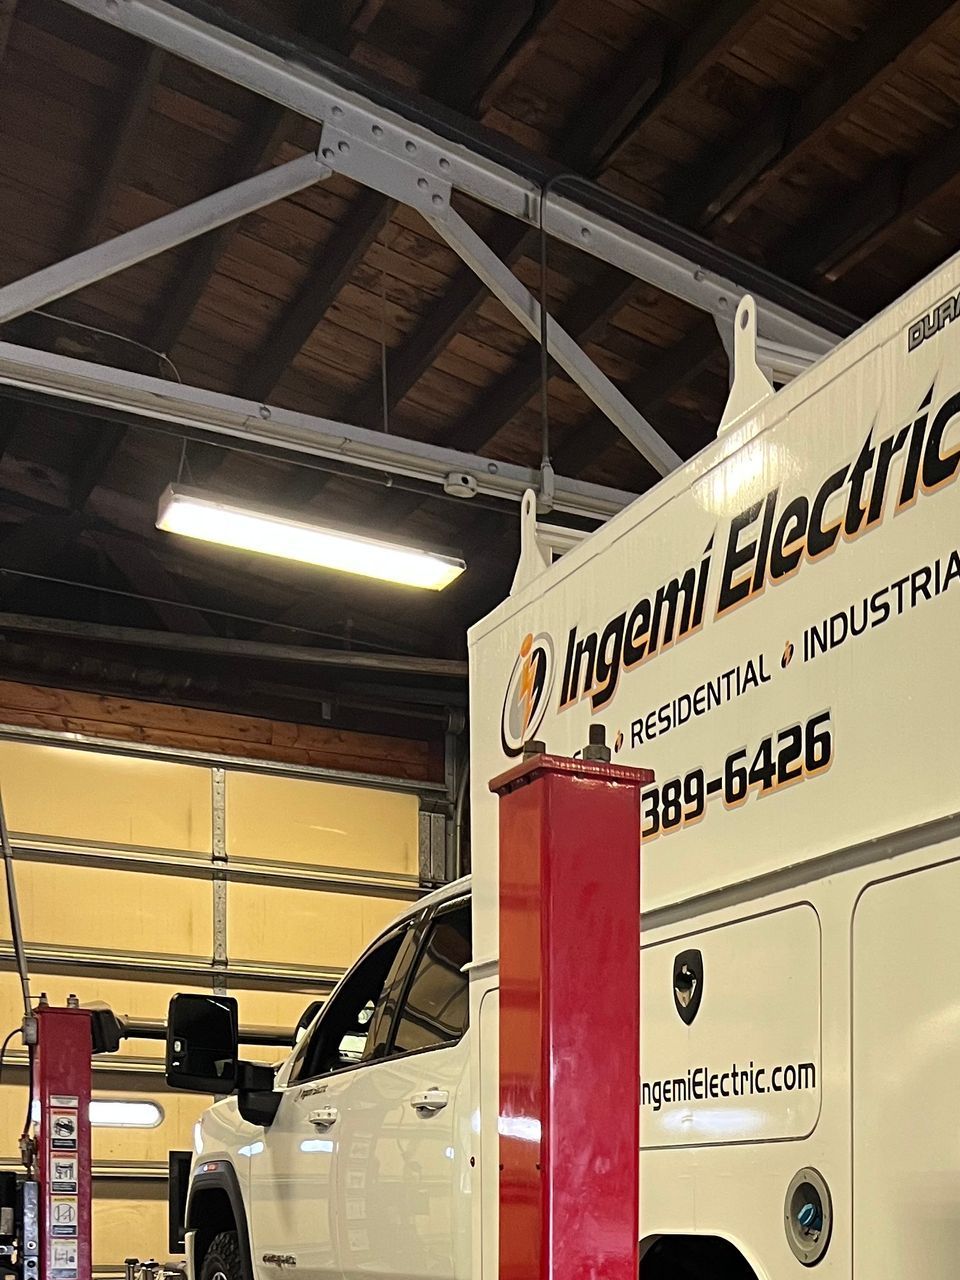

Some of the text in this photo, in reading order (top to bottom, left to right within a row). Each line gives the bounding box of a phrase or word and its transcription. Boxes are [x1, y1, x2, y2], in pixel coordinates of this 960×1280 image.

[558, 527, 716, 711] Ingemi
[631, 654, 771, 749] RESIDENTIAL
[641, 709, 832, 839] 389-6426
